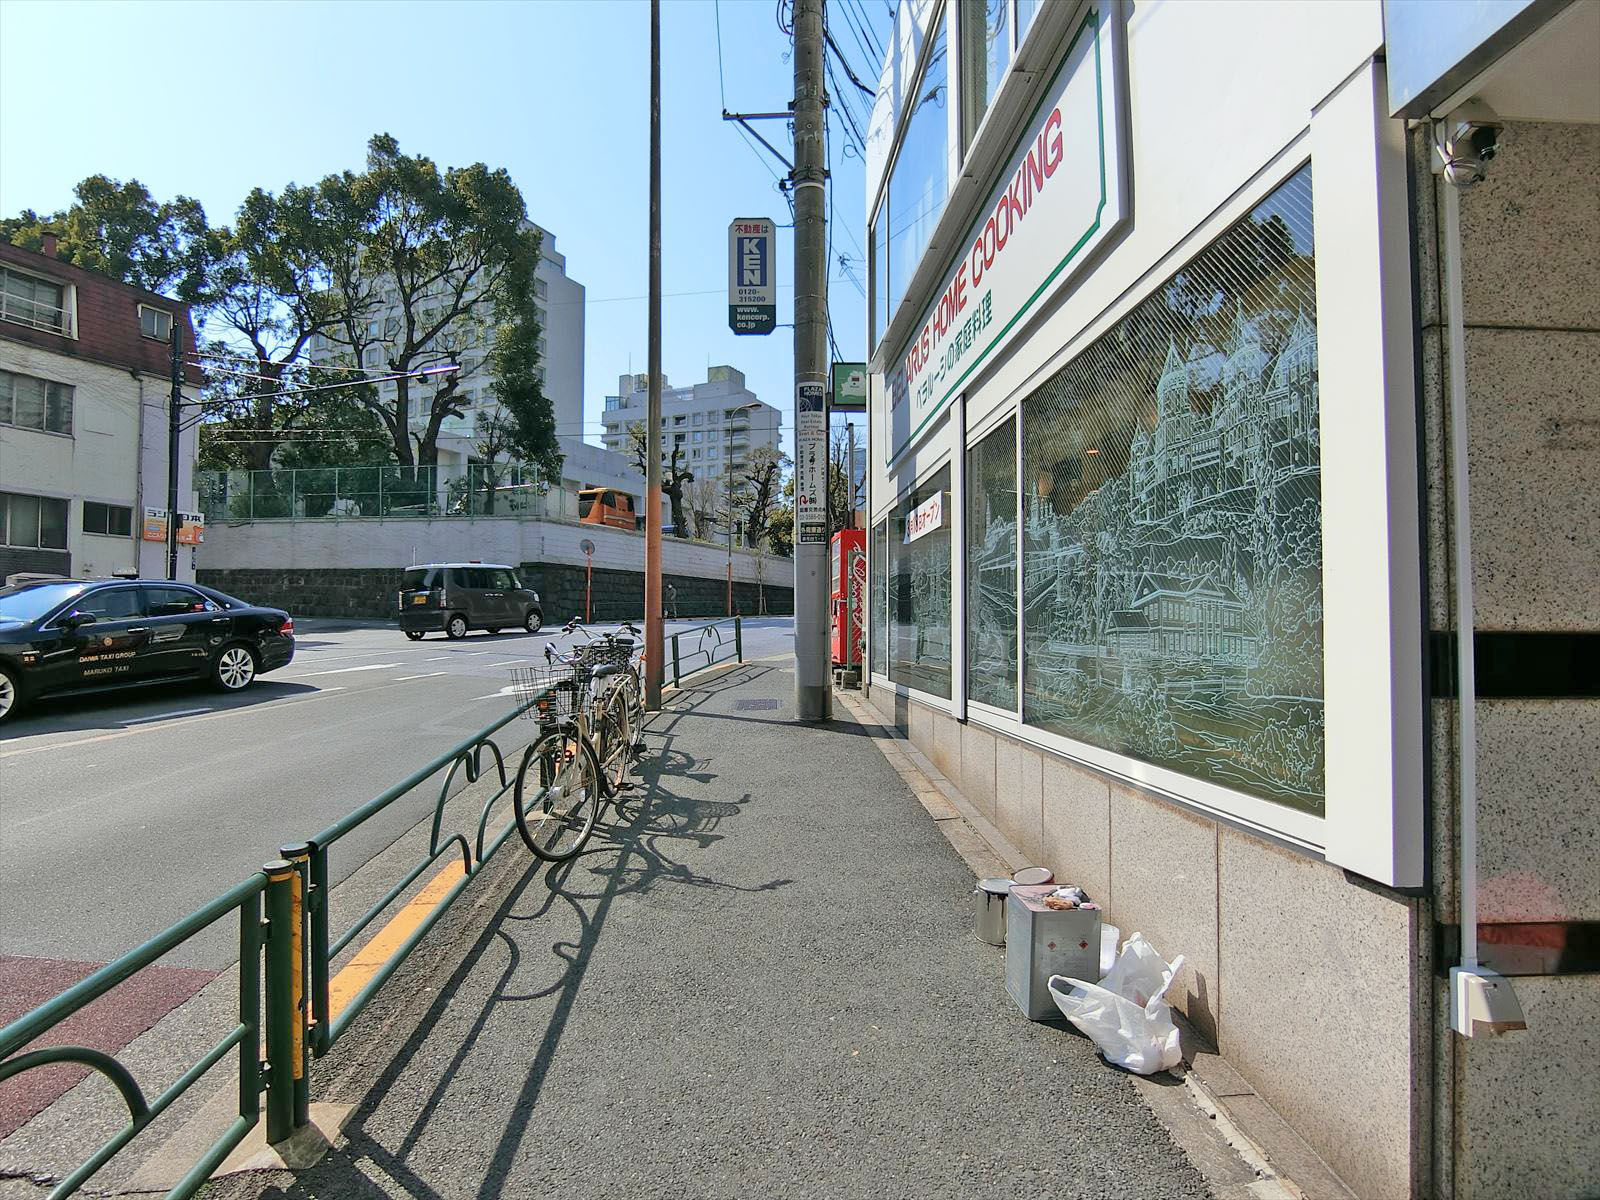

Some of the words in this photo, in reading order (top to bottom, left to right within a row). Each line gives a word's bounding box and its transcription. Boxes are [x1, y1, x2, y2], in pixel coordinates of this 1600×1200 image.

[735, 224, 769, 234] 不動産は
[933, 260, 967, 350] HOME
[972, 108, 1063, 288] COOKING
[743, 239, 760, 286] KEN
[736, 314, 770, 322] kencorp.
[736, 321, 756, 329] co.jp
[115, 651, 136, 659] GROUP
